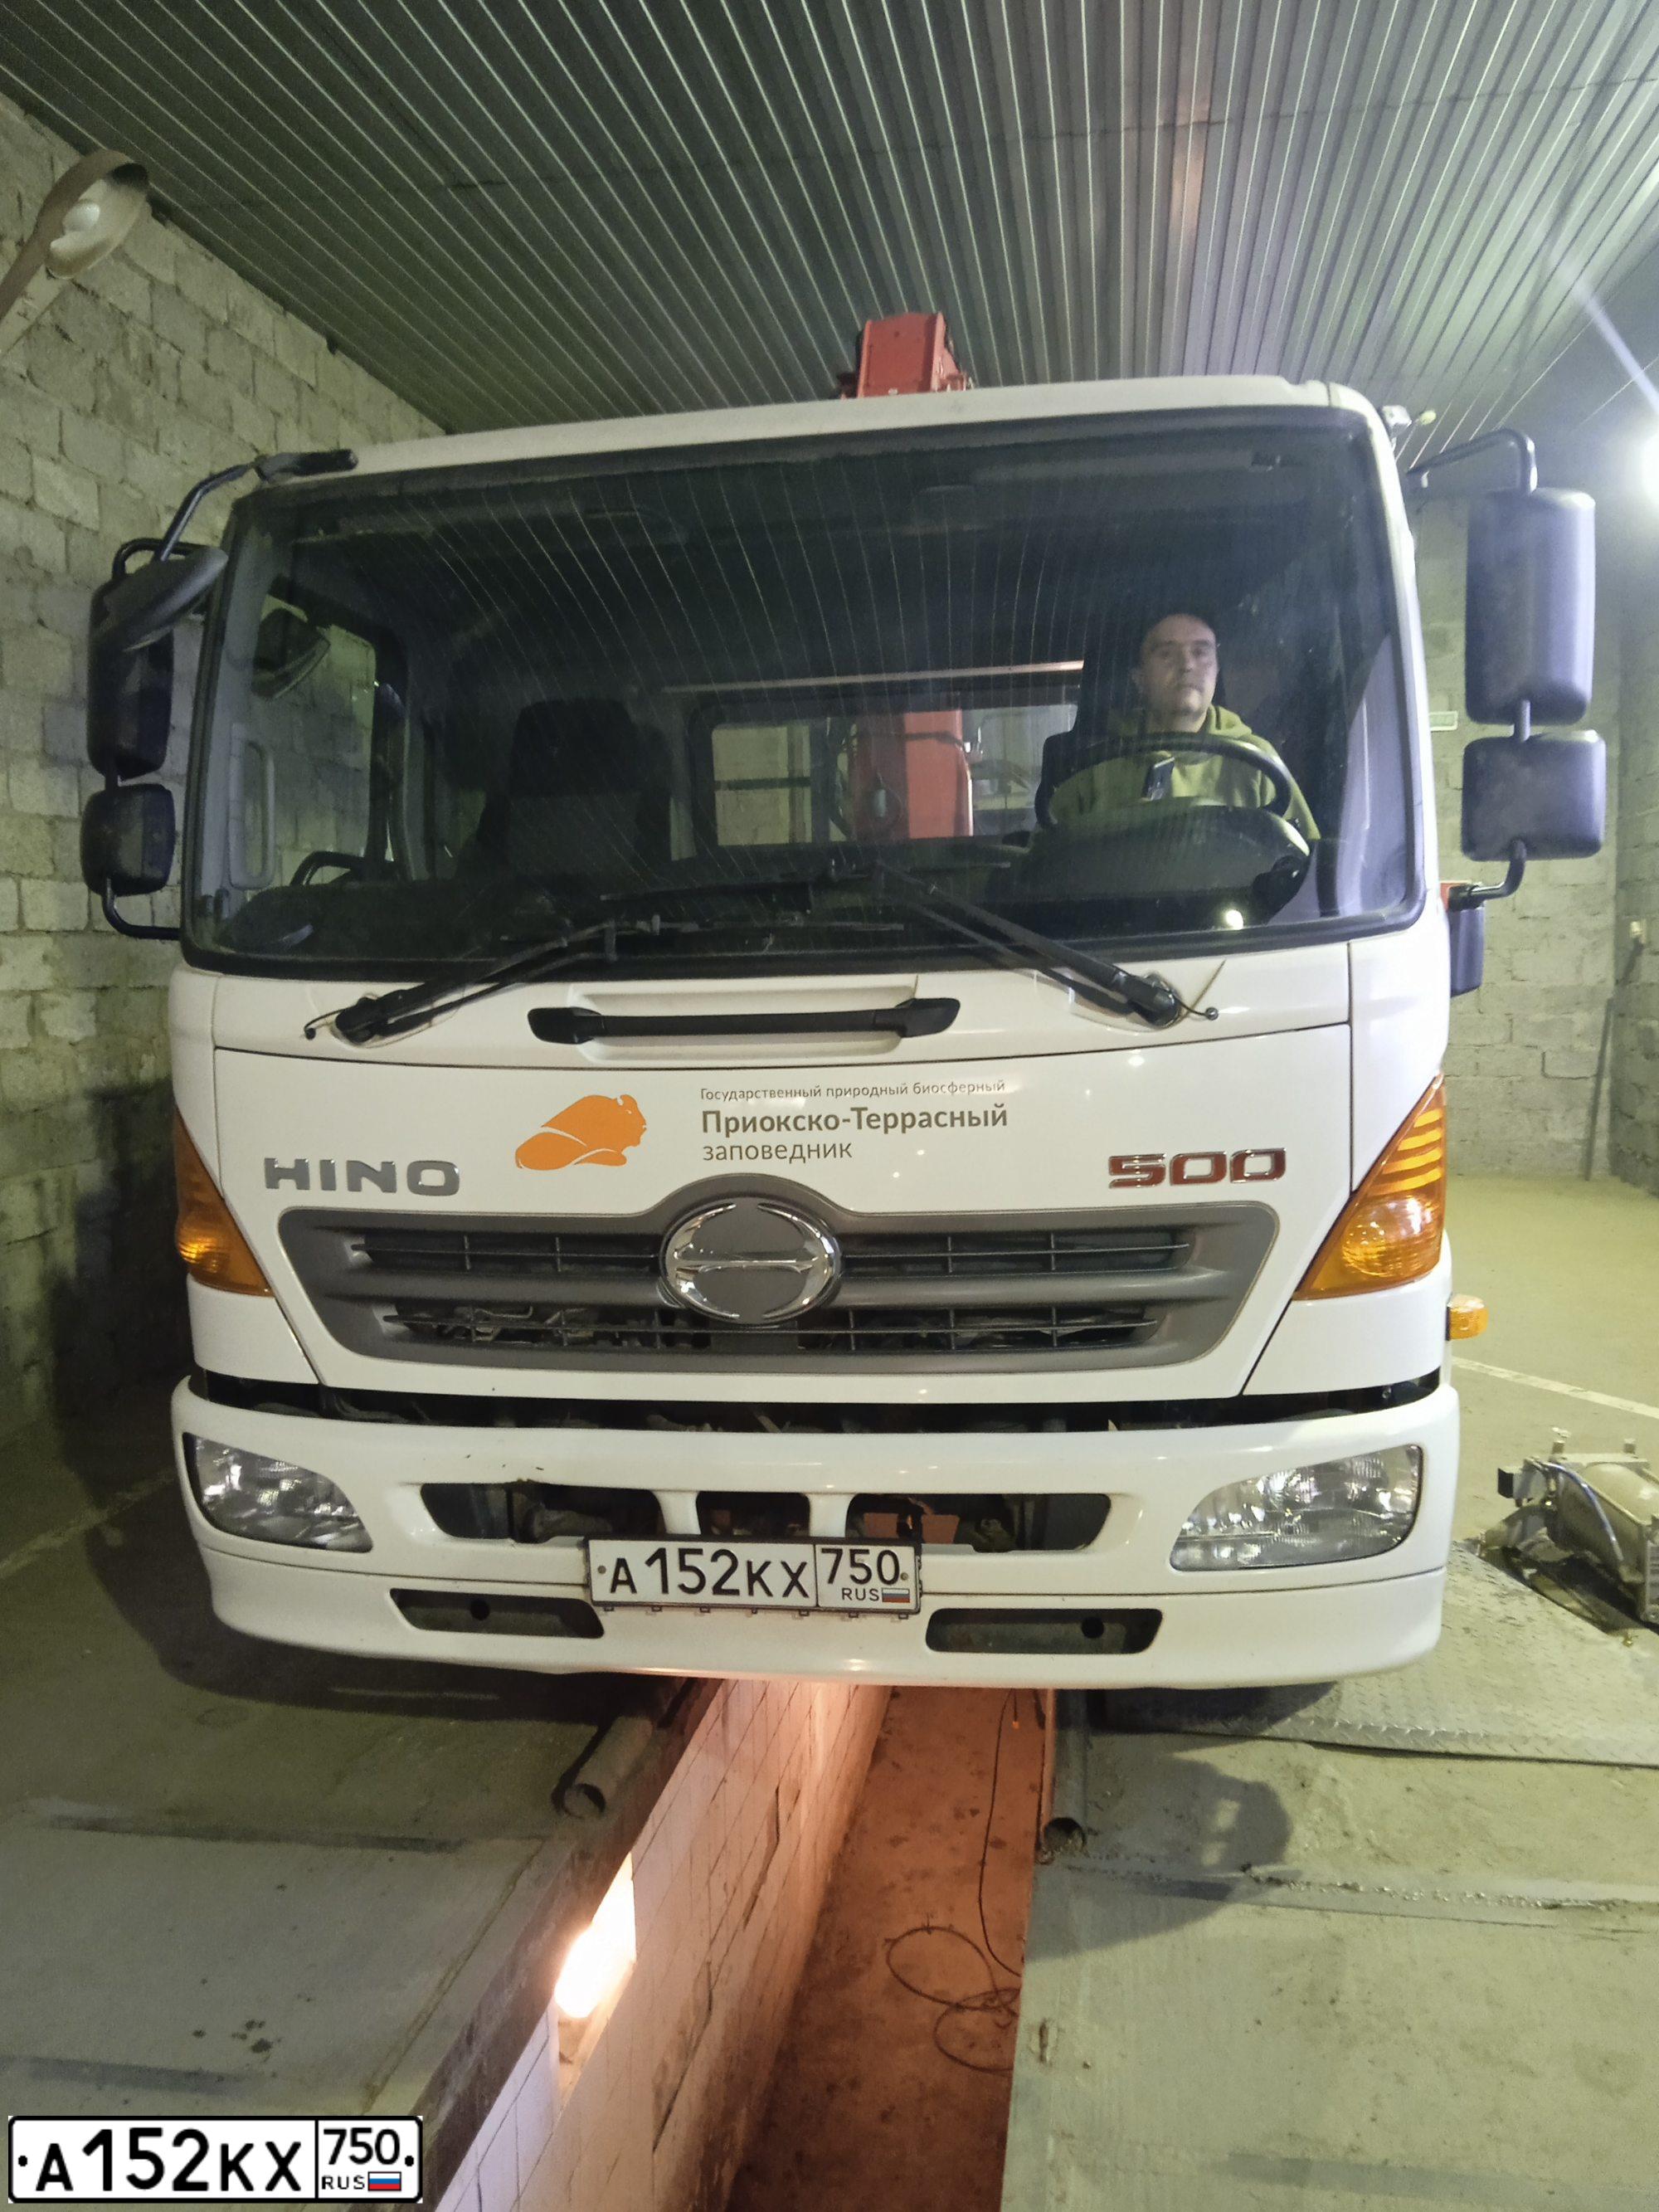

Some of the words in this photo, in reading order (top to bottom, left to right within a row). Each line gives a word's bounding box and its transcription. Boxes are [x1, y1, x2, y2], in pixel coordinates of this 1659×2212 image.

[700, 1085, 822, 1102] Государственный
[825, 1082, 909, 1099] природный
[912, 1079, 1005, 1096] биосферный
[702, 1104, 1008, 1138] Приокско-Террасный
[703, 1141, 853, 1164] заповедник
[1108, 1147, 1286, 1189] 500
[264, 1157, 460, 1196] HINO
[820, 1547, 901, 1586] 750
[841, 1587, 879, 1602] RUS
